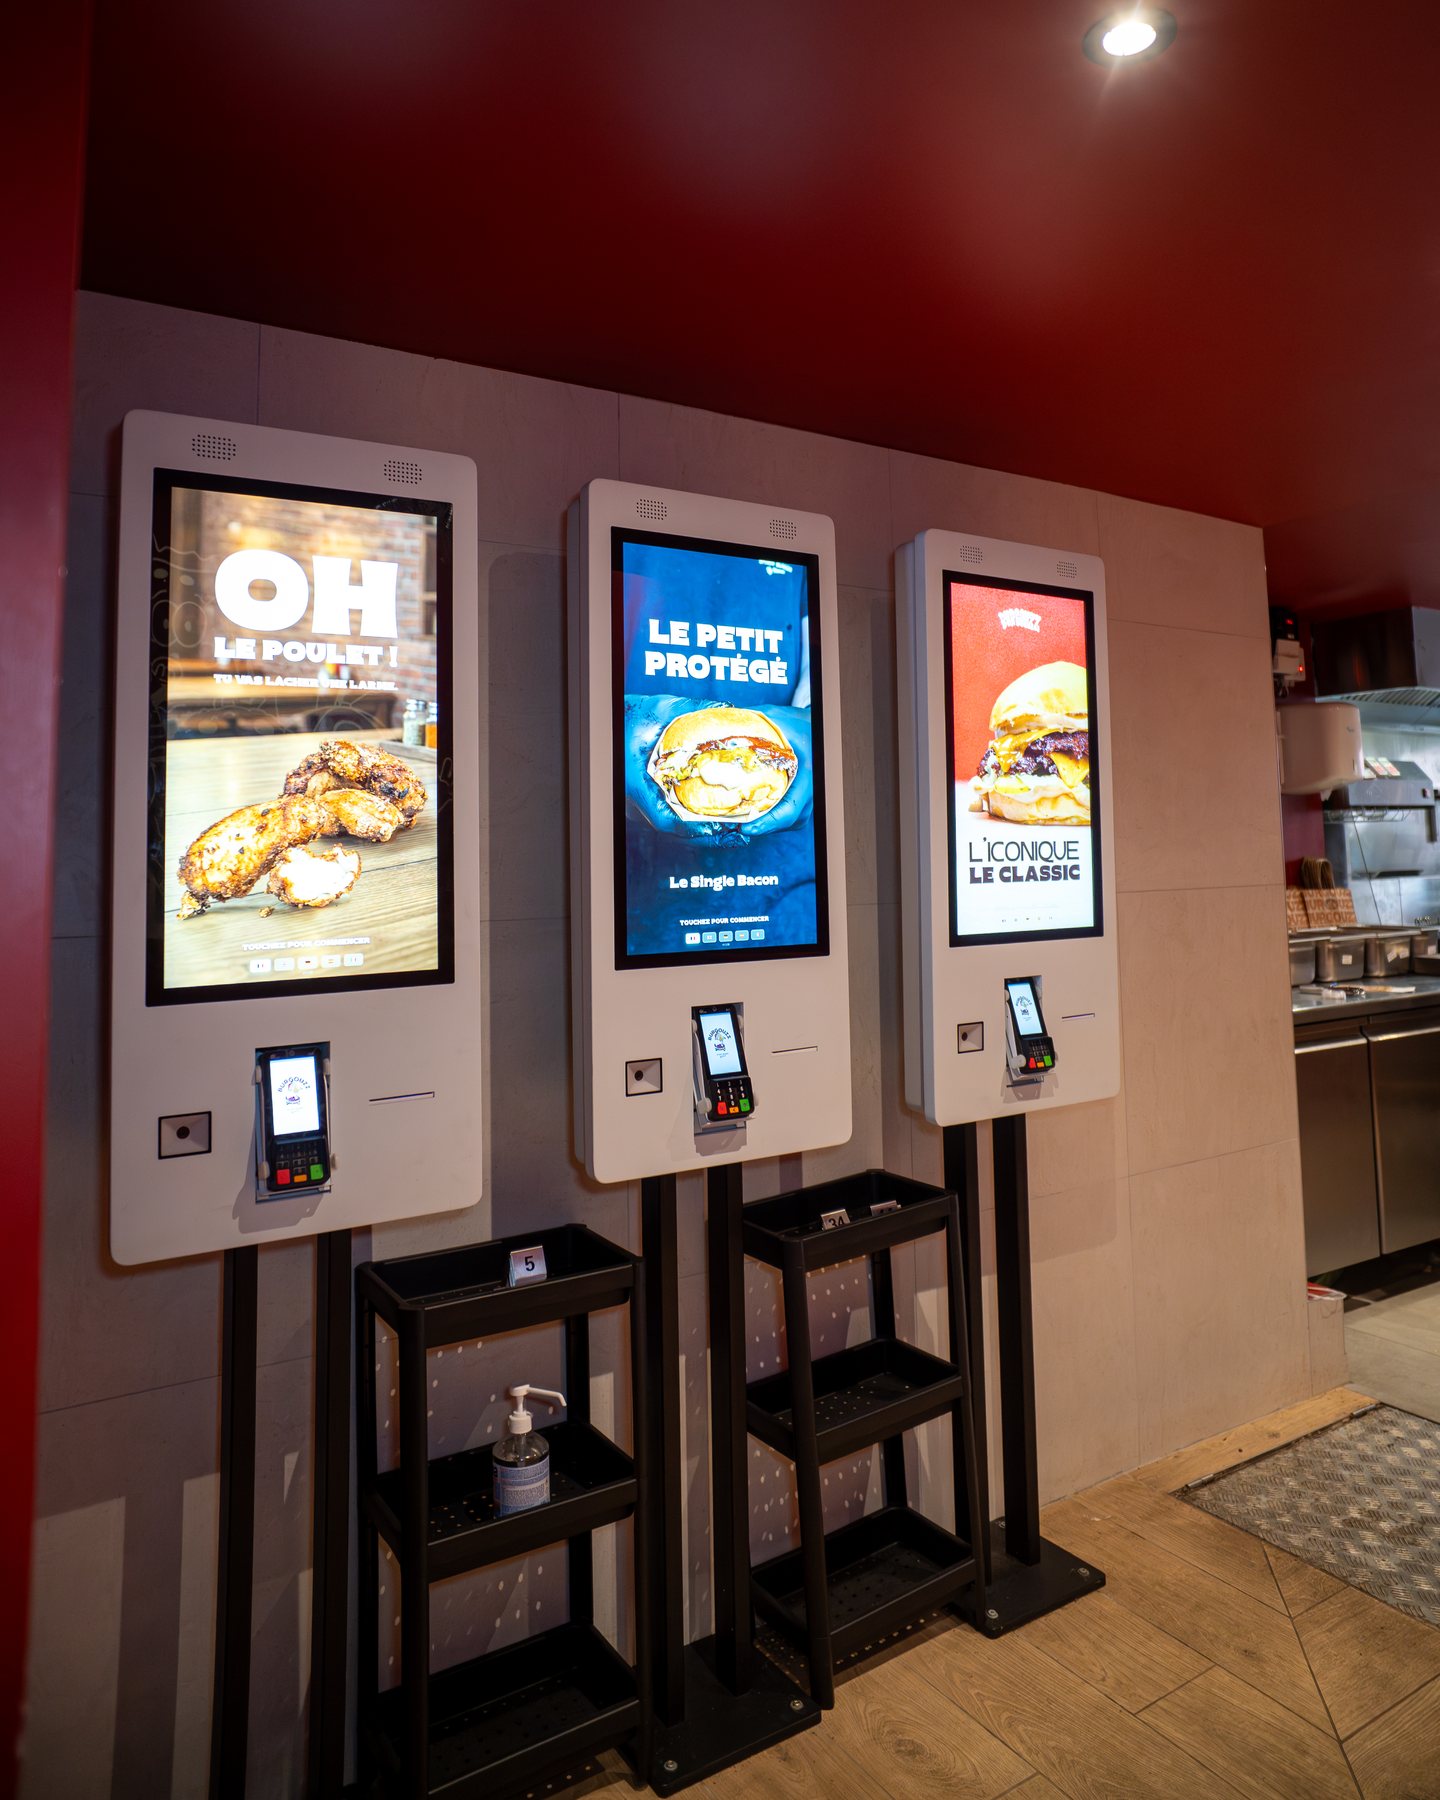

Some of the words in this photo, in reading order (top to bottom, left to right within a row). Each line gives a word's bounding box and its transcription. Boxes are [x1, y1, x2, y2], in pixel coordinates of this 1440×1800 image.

[215, 549, 399, 639] OH
[649, 618, 690, 646] LE
[696, 623, 783, 654] PETIT
[214, 637, 257, 660] LE
[262, 640, 383, 666] POULET
[644, 650, 788, 685] PROTÉGÉ
[213, 674, 233, 685] TU
[235, 674, 264, 686] VAS
[969, 836, 1080, 864] L'ICONIQUE
[669, 876, 688, 889] Le
[690, 874, 735, 892] Single
[737, 874, 779, 887] Bacon
[969, 866, 994, 885] LE
[999, 864, 1081, 883] CLASSIC
[680, 918, 710, 926] TOUCHEZ
[711, 917, 729, 925] POUR
[730, 915, 770, 924] COMMENCER
[524, 1255, 536, 1272] 5
